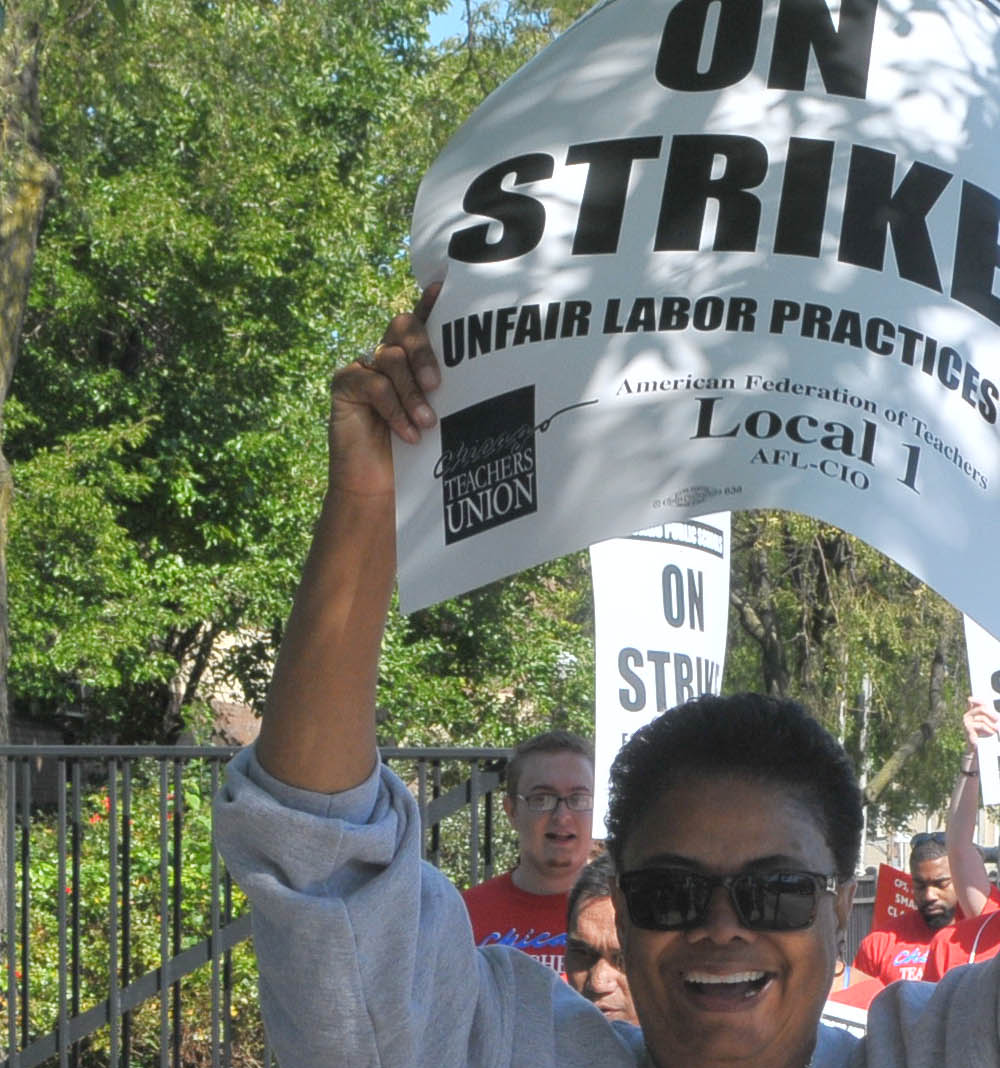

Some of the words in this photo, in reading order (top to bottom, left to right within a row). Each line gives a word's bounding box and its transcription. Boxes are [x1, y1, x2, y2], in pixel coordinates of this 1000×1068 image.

[654, 0, 877, 99] ON
[441, 299, 592, 367] UNFAIR
[602, 295, 756, 334] LABOR
[769, 299, 1000, 426] PRACTICES
[444, 447, 534, 501] TEACHERS
[616, 374, 736, 396] American
[744, 374, 877, 416] Federation
[884, 406, 908, 427] of
[911, 415, 989, 491] Teachers
[689, 396, 877, 467] Local
[896, 440, 923, 497] 1
[749, 447, 871, 491] AFL-CIO
[446, 472, 534, 533] UNION
[662, 564, 704, 632] ON
